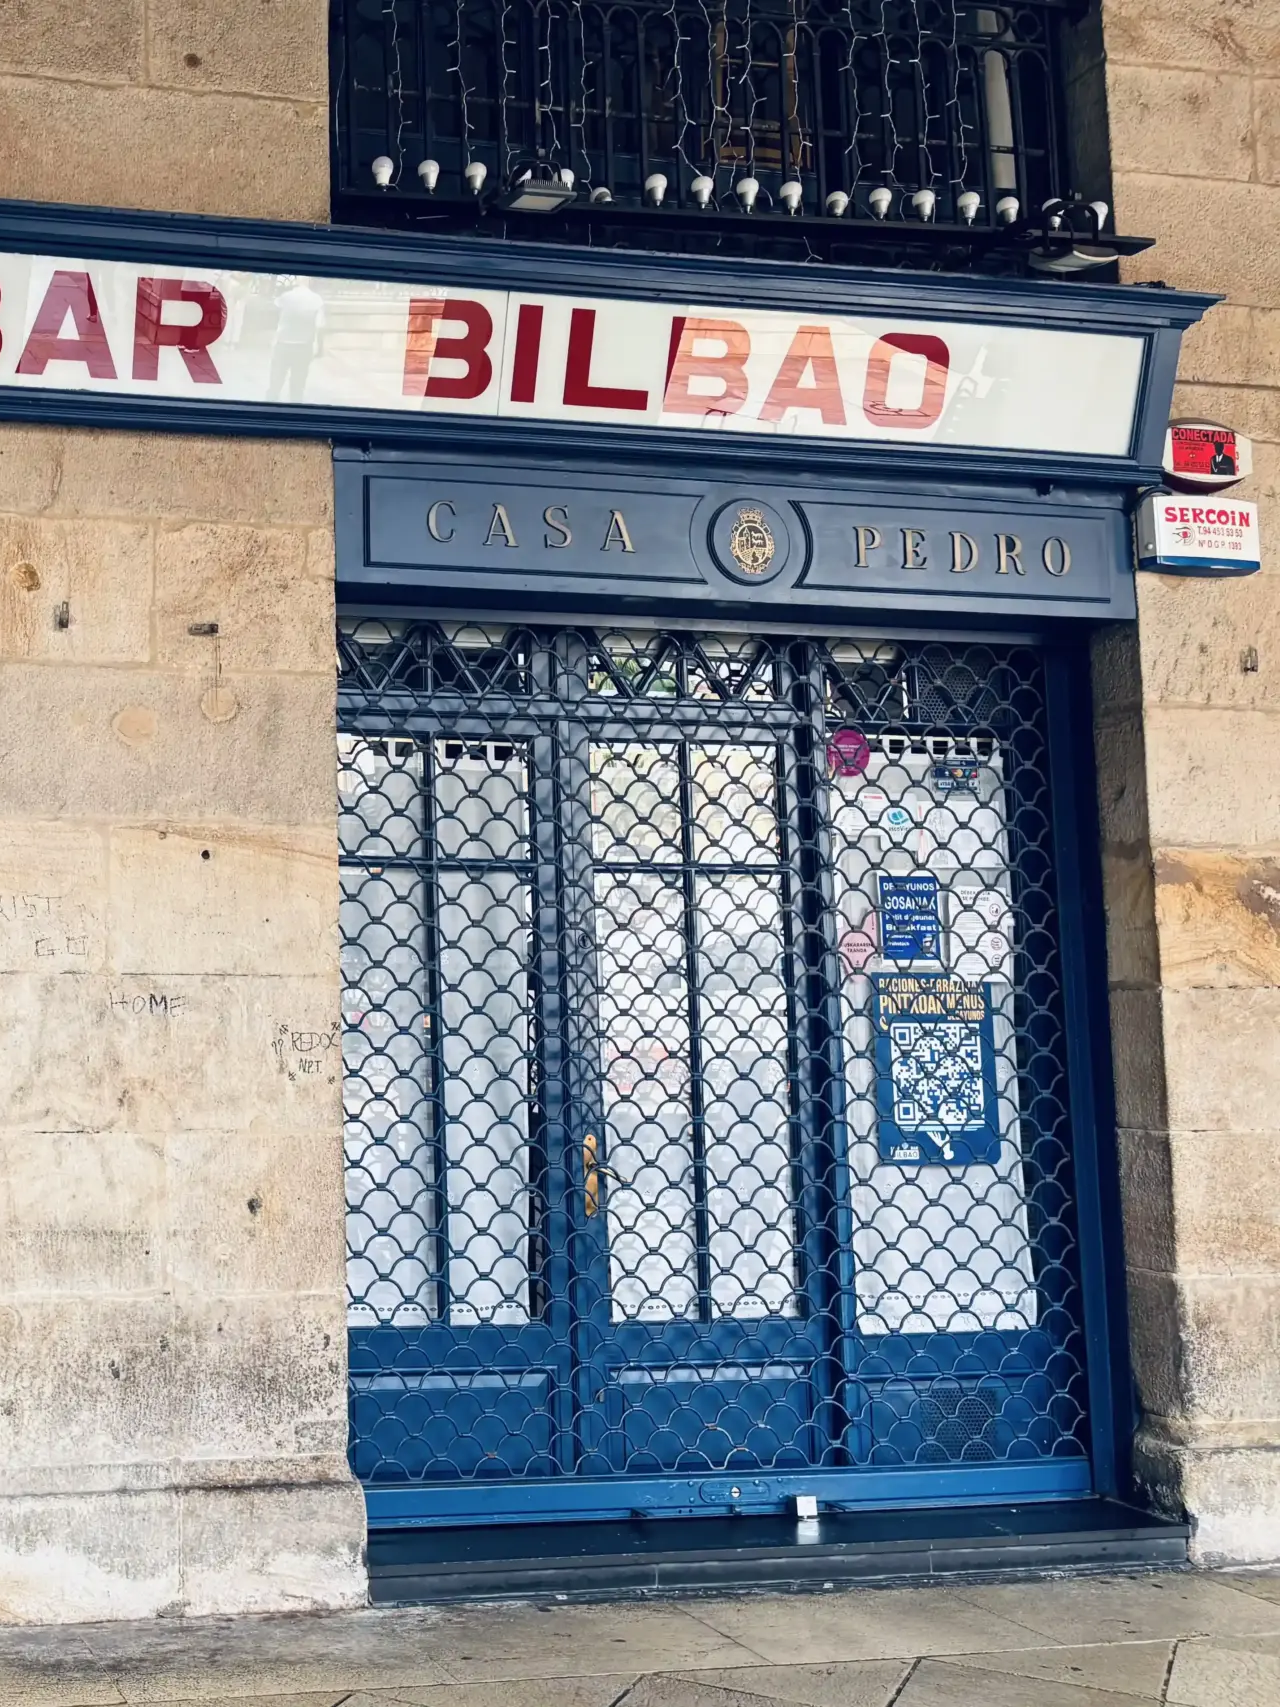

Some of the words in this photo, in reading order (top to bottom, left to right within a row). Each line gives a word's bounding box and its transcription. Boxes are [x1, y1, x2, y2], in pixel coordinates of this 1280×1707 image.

[401, 298, 951, 430] BILBAO
[1171, 428, 1234, 444] CONECTADA
[426, 500, 637, 554] CASA
[852, 525, 1072, 577] PEDRO
[883, 882, 934, 891] DEYUNOS
[885, 923, 937, 931] Brkfast
[903, 914, 935, 922] djeuner
[109, 992, 186, 1017] HOME
